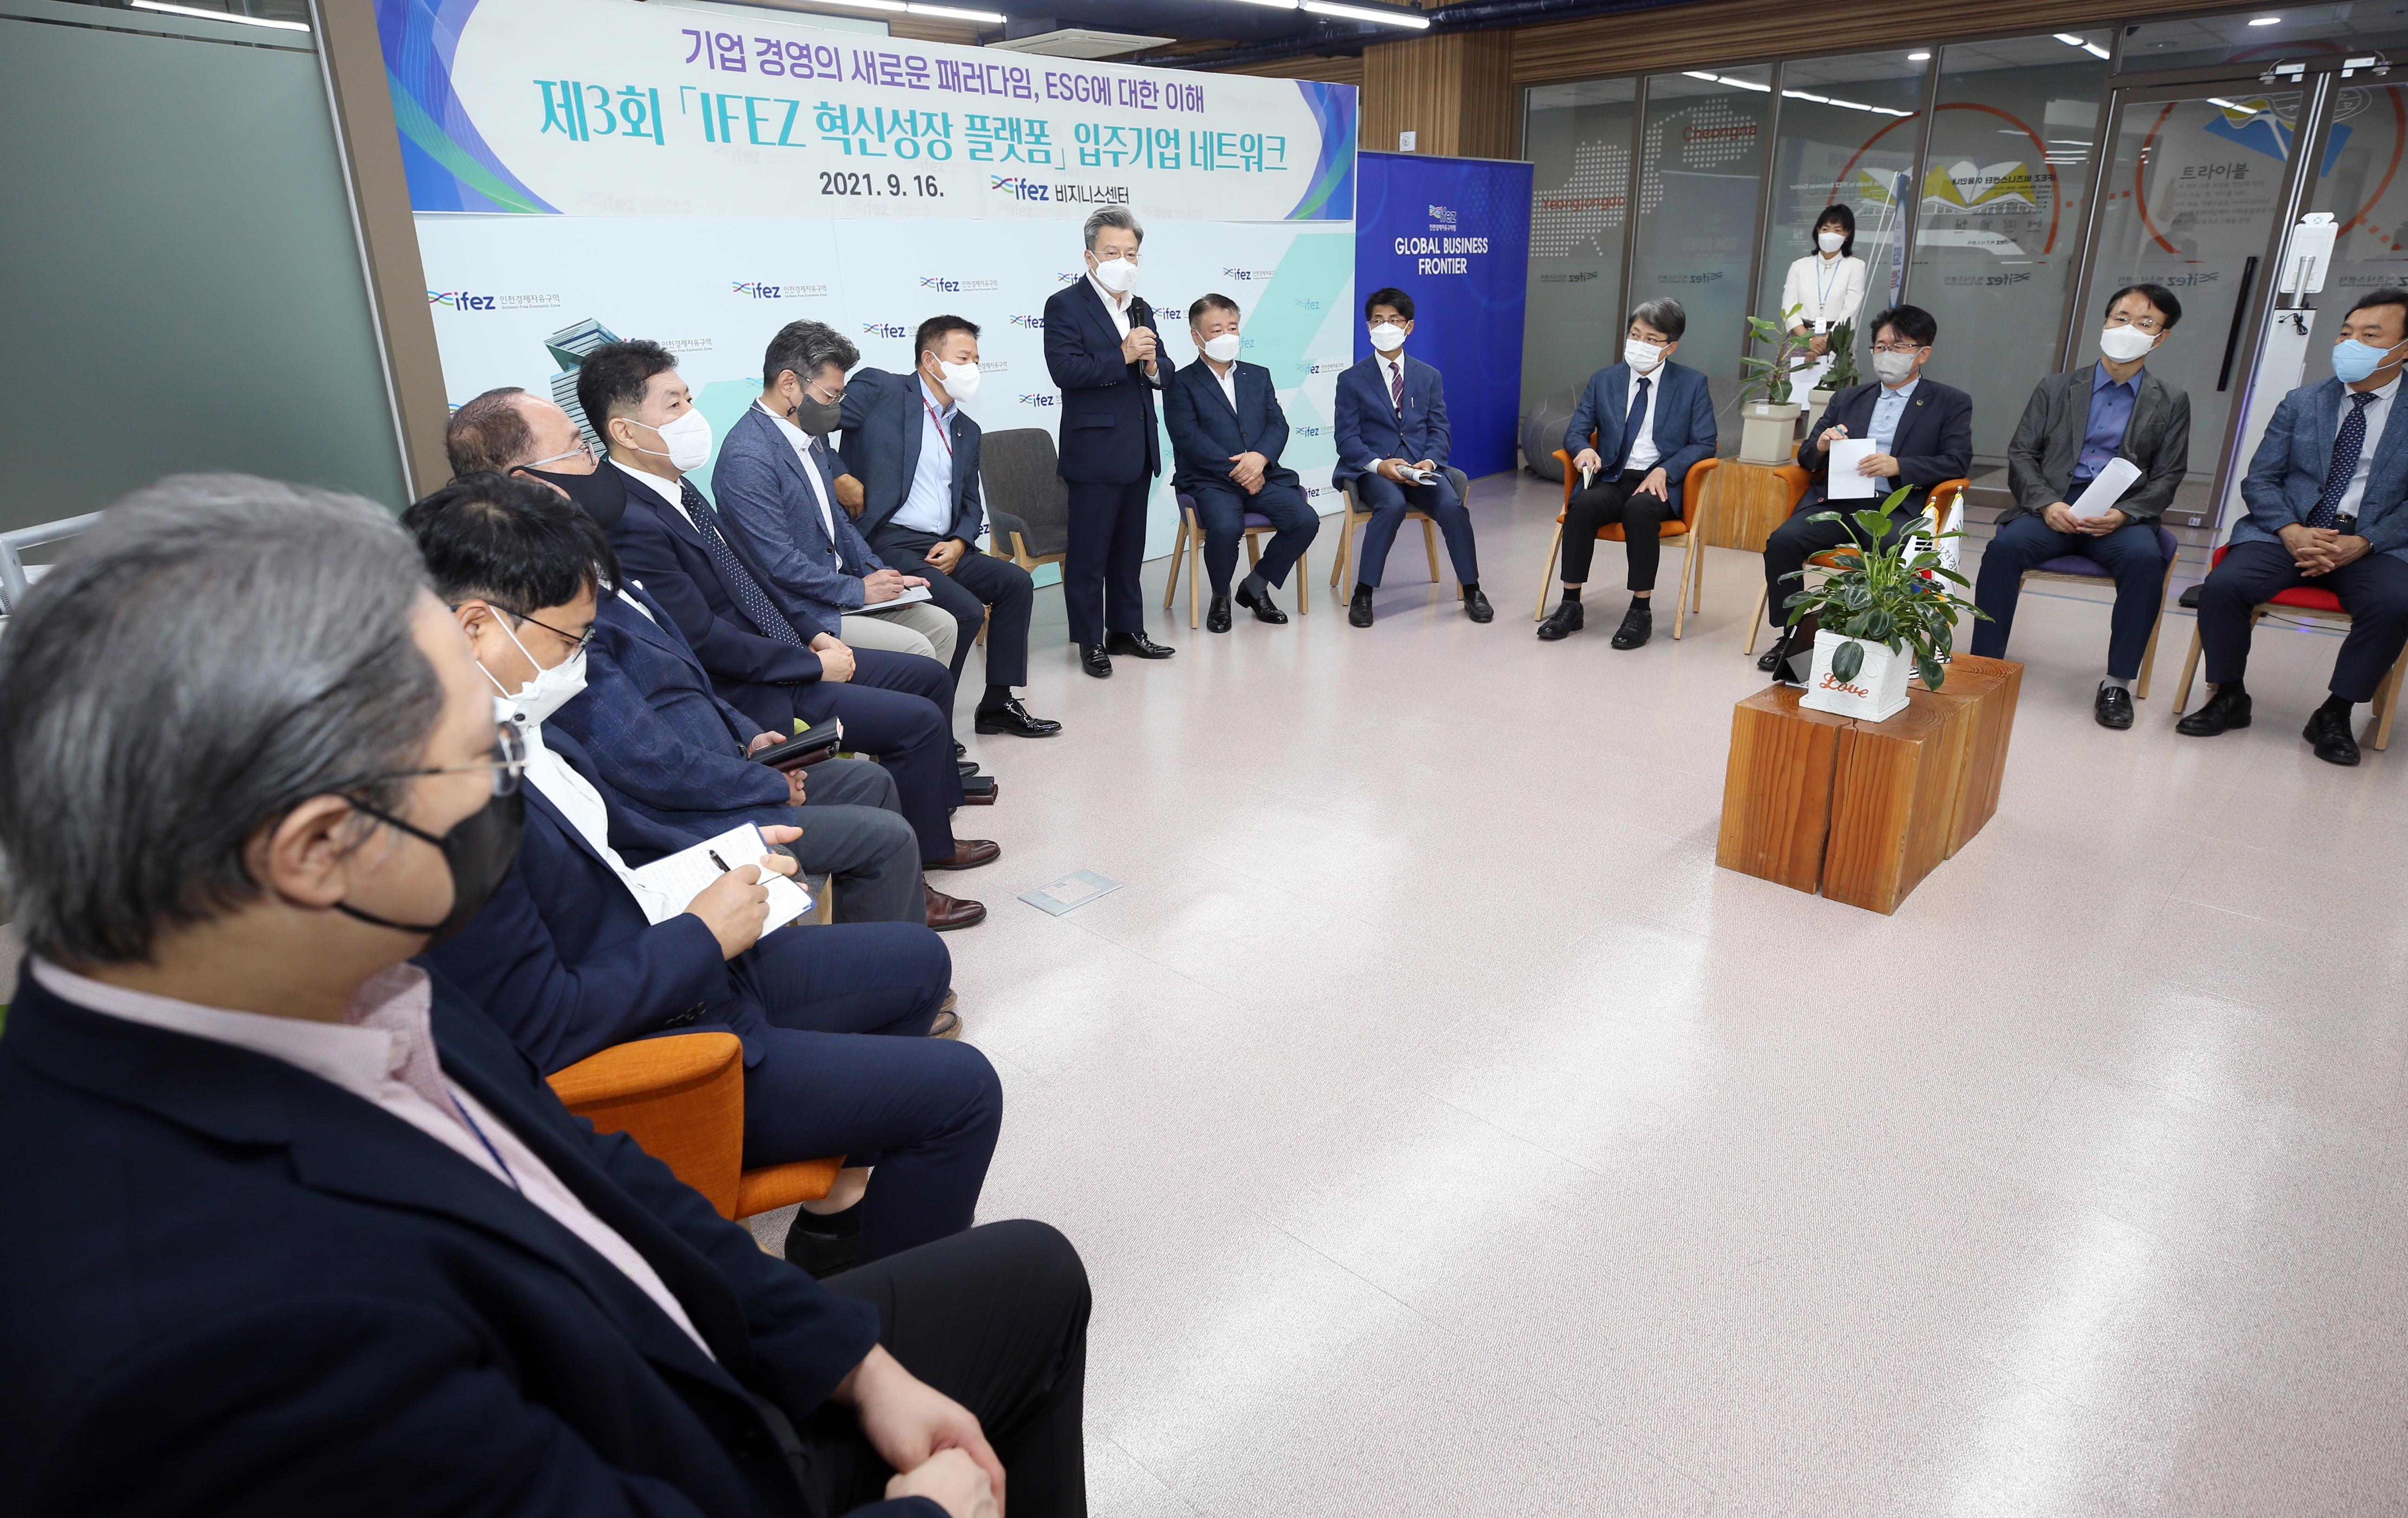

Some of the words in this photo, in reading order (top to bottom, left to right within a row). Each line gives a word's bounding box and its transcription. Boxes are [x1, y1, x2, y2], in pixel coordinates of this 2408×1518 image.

[682, 29, 747, 73] 기업
[754, 37, 843, 82] 경영의
[851, 49, 930, 90] 새로운
[935, 59, 1040, 104] 패러다임,
[1045, 72, 1112, 106] ESG에
[1118, 79, 1159, 110] 대한
[1165, 83, 1204, 113] 이해
[533, 79, 665, 145] 제3회
[813, 101, 954, 161] 혁신성장
[1074, 123, 1181, 170] 입주기업
[1190, 130, 1288, 172] 네트워크
[1683, 124, 1757, 140] Cheongna
[2179, 163, 2249, 180] 트라이볼
[819, 171, 881, 196] 2021.
[887, 174, 907, 196] 9.
[913, 175, 944, 197] 16.
[1014, 177, 1049, 201] ifez
[1054, 184, 1129, 204] 비지니스센터
[1543, 194, 1625, 211] Yeongjongdo
[1440, 207, 1456, 223] ifez
[1395, 237, 1440, 255] GLOBAL
[1443, 237, 1488, 254] BUSINESS
[1234, 268, 1251, 280] ifez
[1419, 258, 1467, 275] FRONTIER
[752, 282, 781, 299] ifez
[784, 285, 827, 294] 인천경제자유구역
[936, 277, 960, 292] ifez
[454, 292, 496, 311] ifez
[500, 294, 560, 305] 인천경제자유구역
[1304, 299, 1320, 310] ifez
[1024, 315, 1045, 329] ifez
[1163, 308, 1181, 320] ifez
[880, 323, 905, 338] ifez
[1240, 337, 1254, 348] fez
[977, 361, 1007, 370] 천경제자유구역
[1304, 364, 1320, 374] ifez
[1033, 393, 1054, 407] ifez
[1305, 426, 1319, 437] ifez
[1819, 672, 1868, 698] Love
